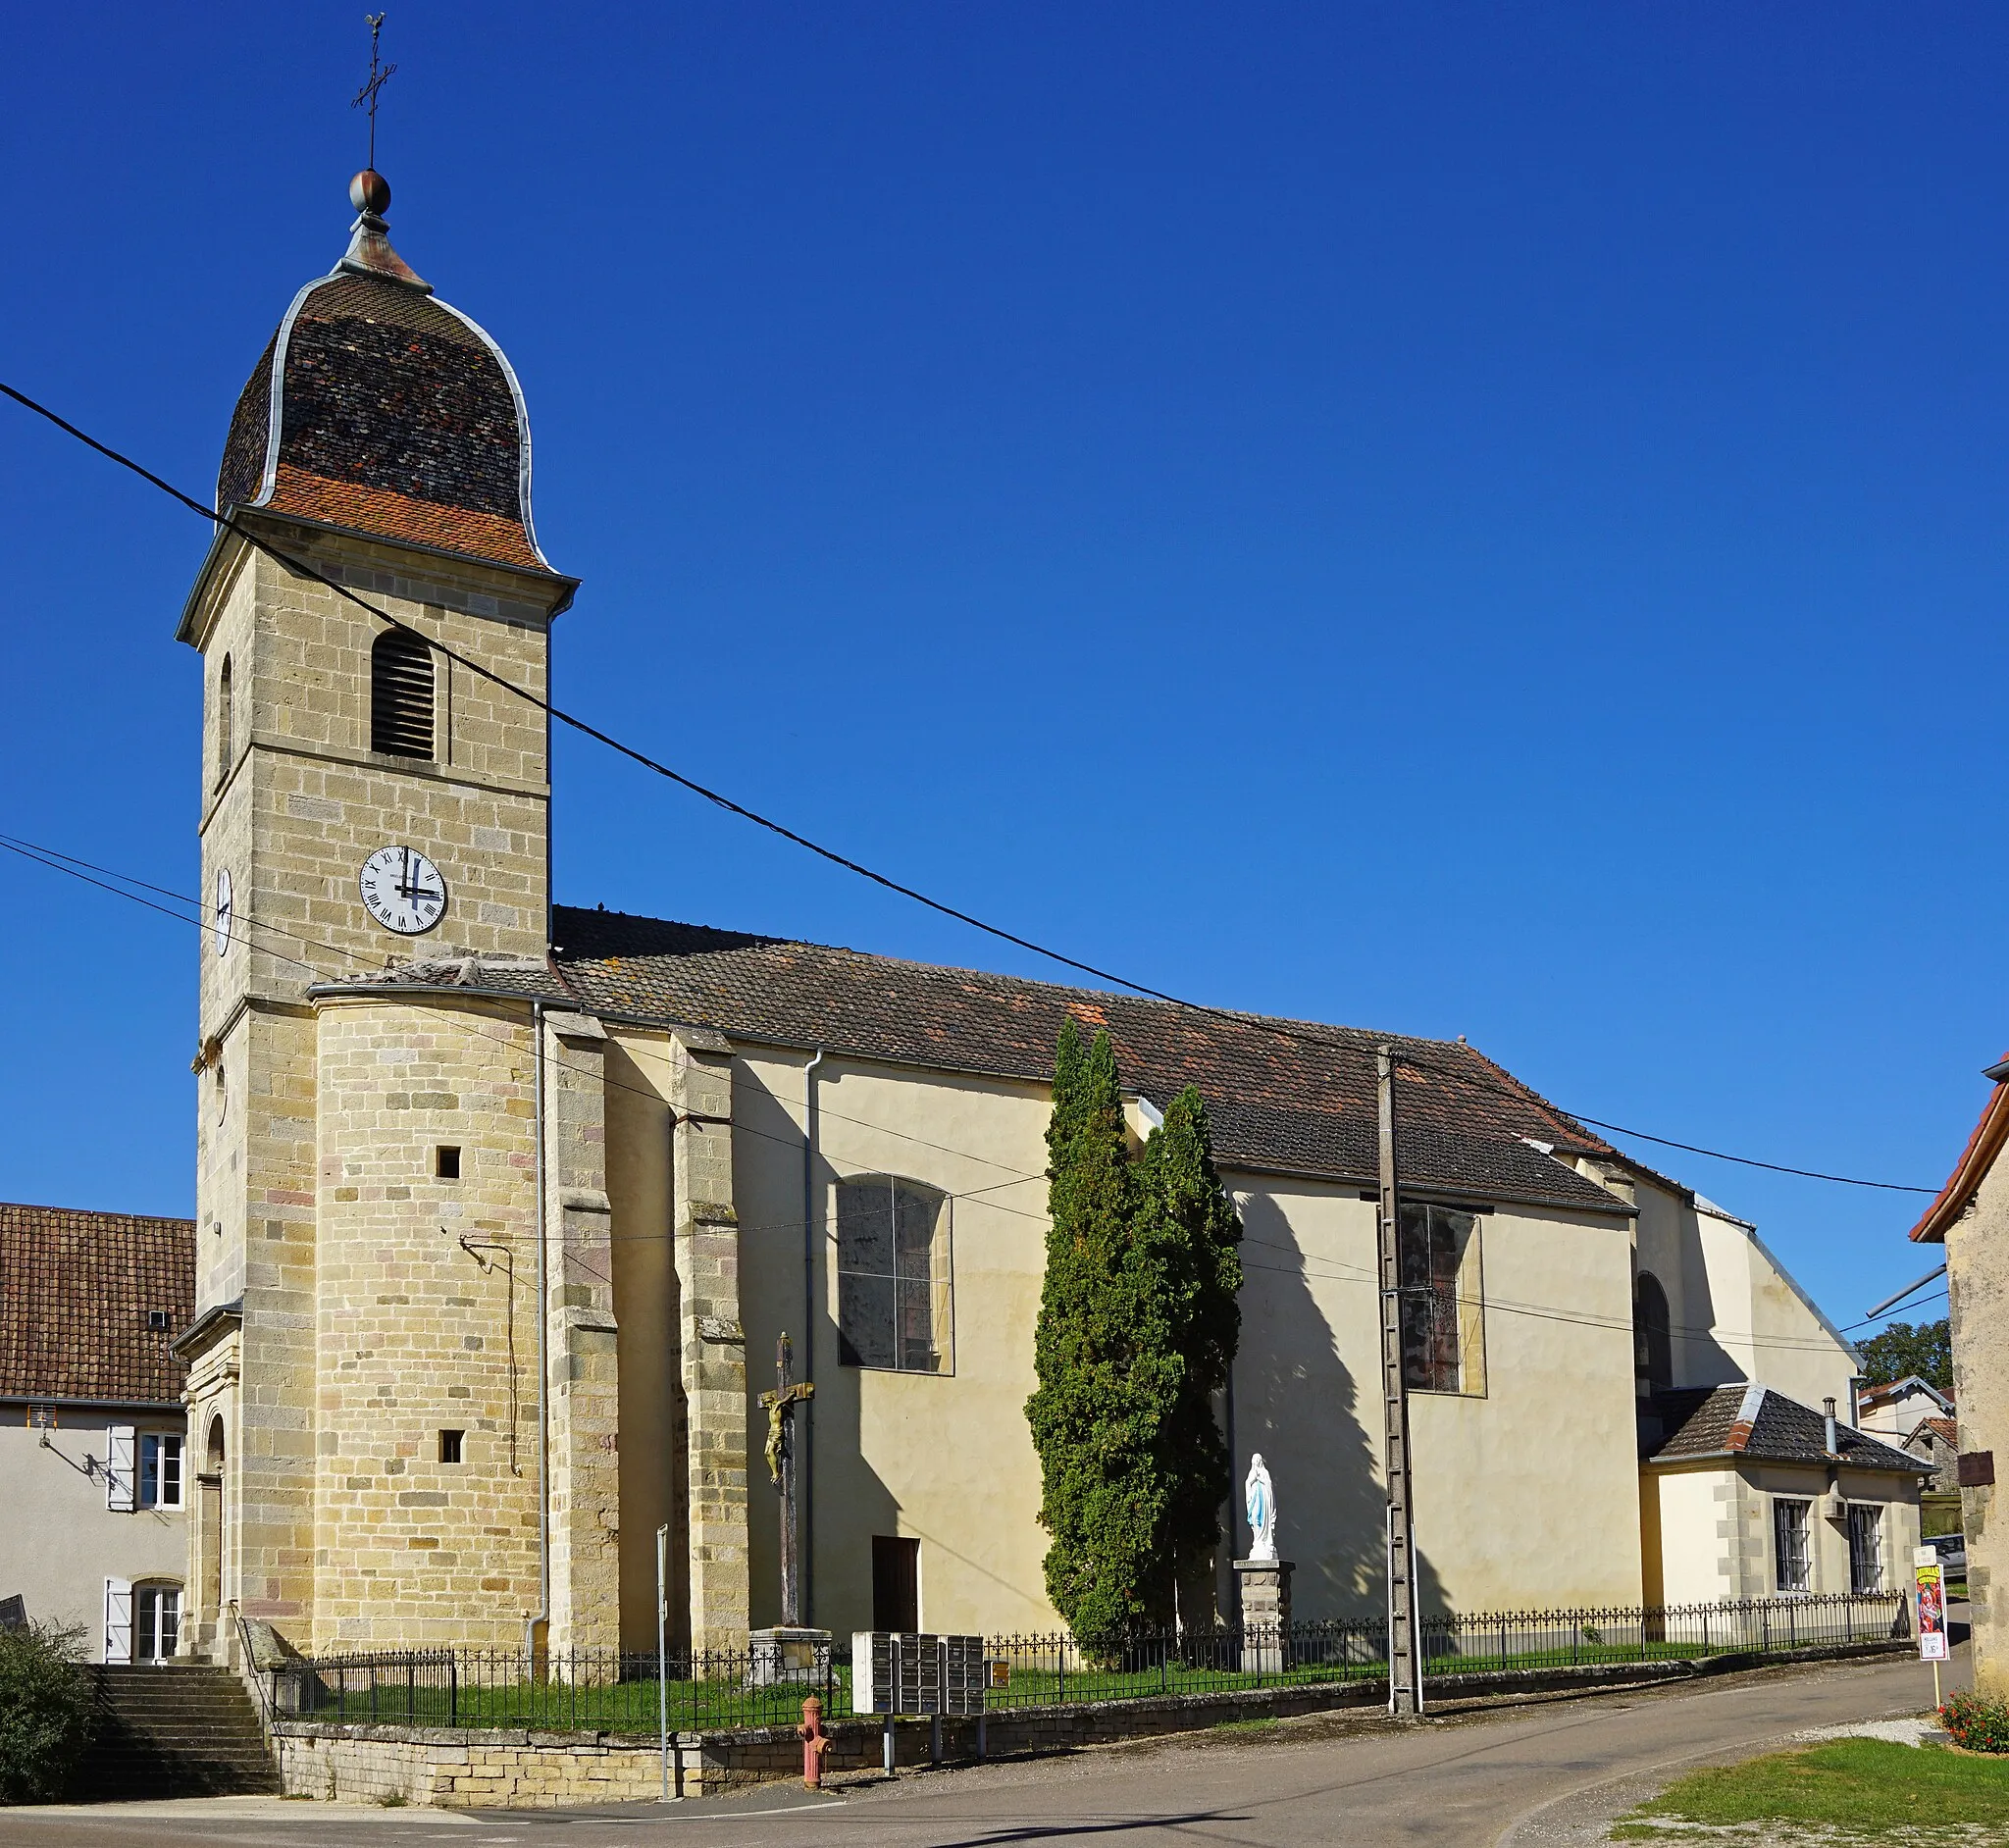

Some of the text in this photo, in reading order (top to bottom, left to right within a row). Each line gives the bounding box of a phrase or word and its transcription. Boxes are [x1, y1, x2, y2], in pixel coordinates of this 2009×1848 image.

[381, 851, 392, 865] XI
[369, 863, 381, 874] X
[425, 873, 436, 882] II
[365, 879, 377, 890] IX
[367, 893, 382, 909] VIII
[380, 907, 392, 922] VII
[424, 902, 437, 916] IIII
[398, 915, 407, 928] VI
[415, 914, 424, 926] V
